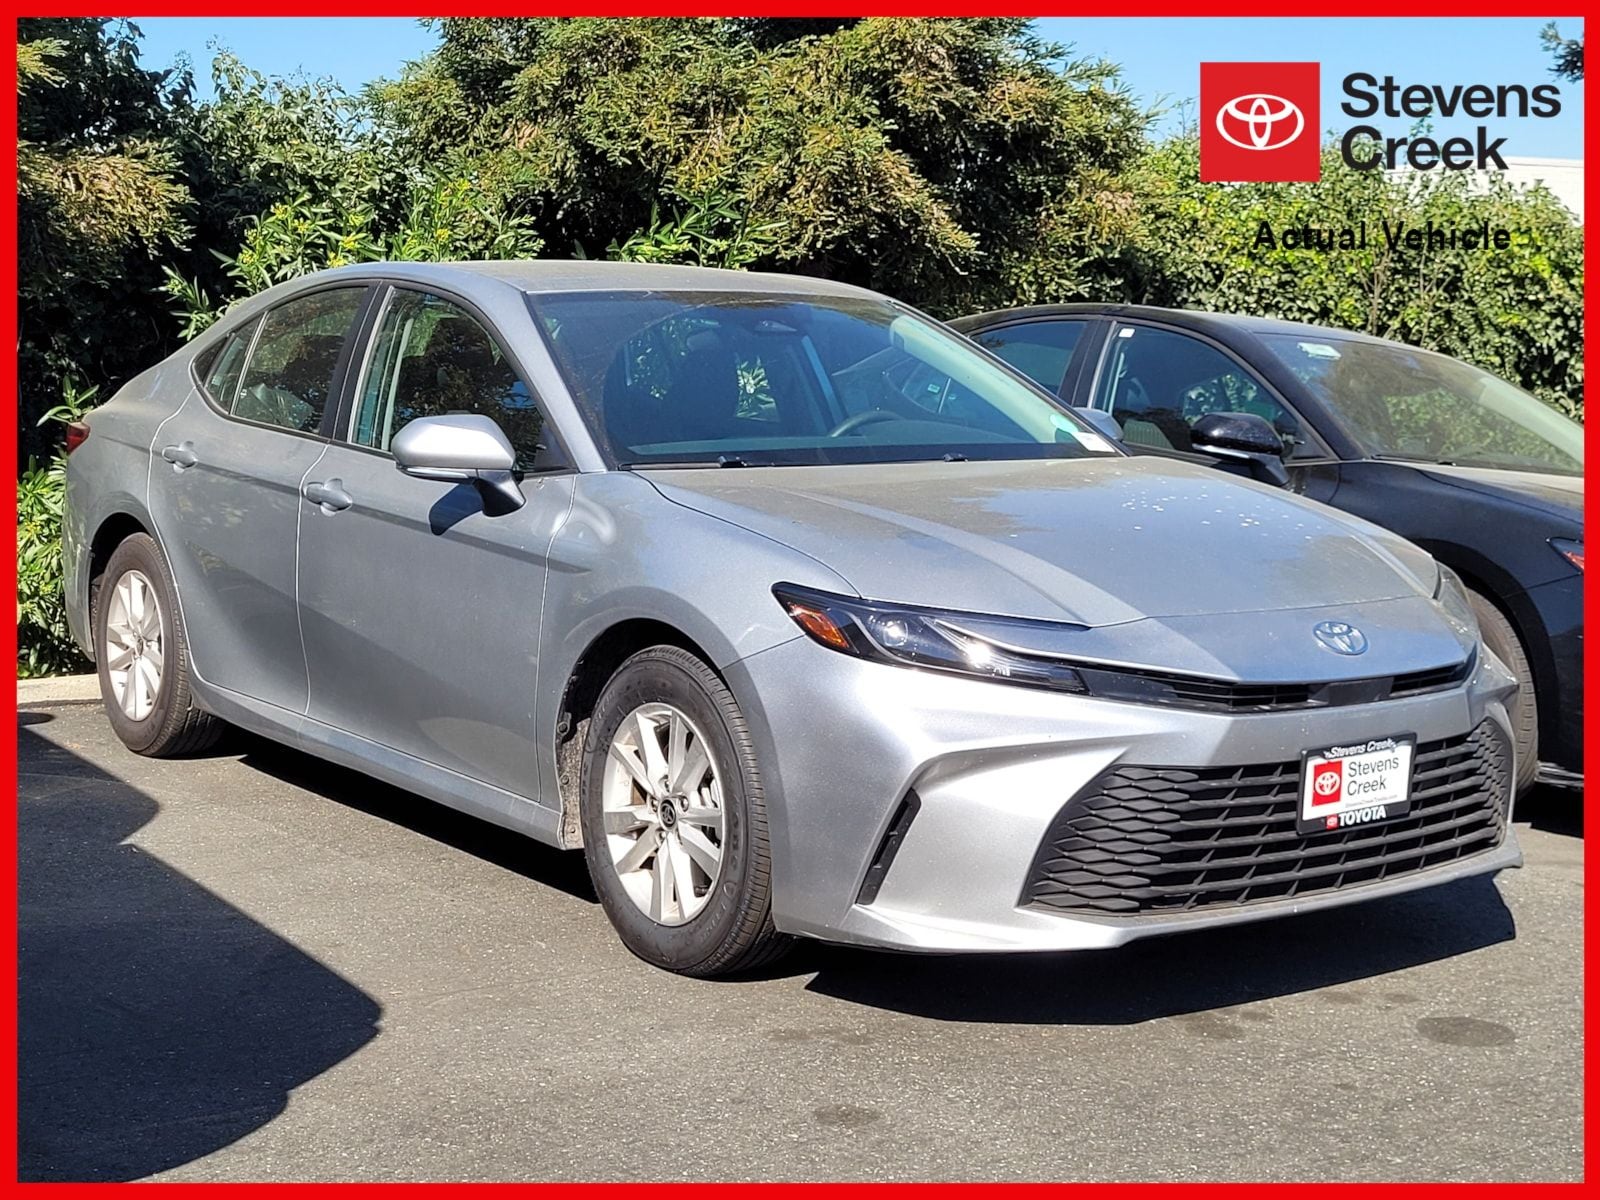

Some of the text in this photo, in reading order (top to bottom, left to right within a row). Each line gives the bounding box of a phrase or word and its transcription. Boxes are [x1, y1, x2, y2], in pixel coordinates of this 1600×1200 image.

[1330, 738, 1395, 758] Stevens Creek
[1348, 757, 1399, 778] Stevens
[1347, 775, 1387, 796] Creek
[1339, 805, 1387, 826] TOYOTA
